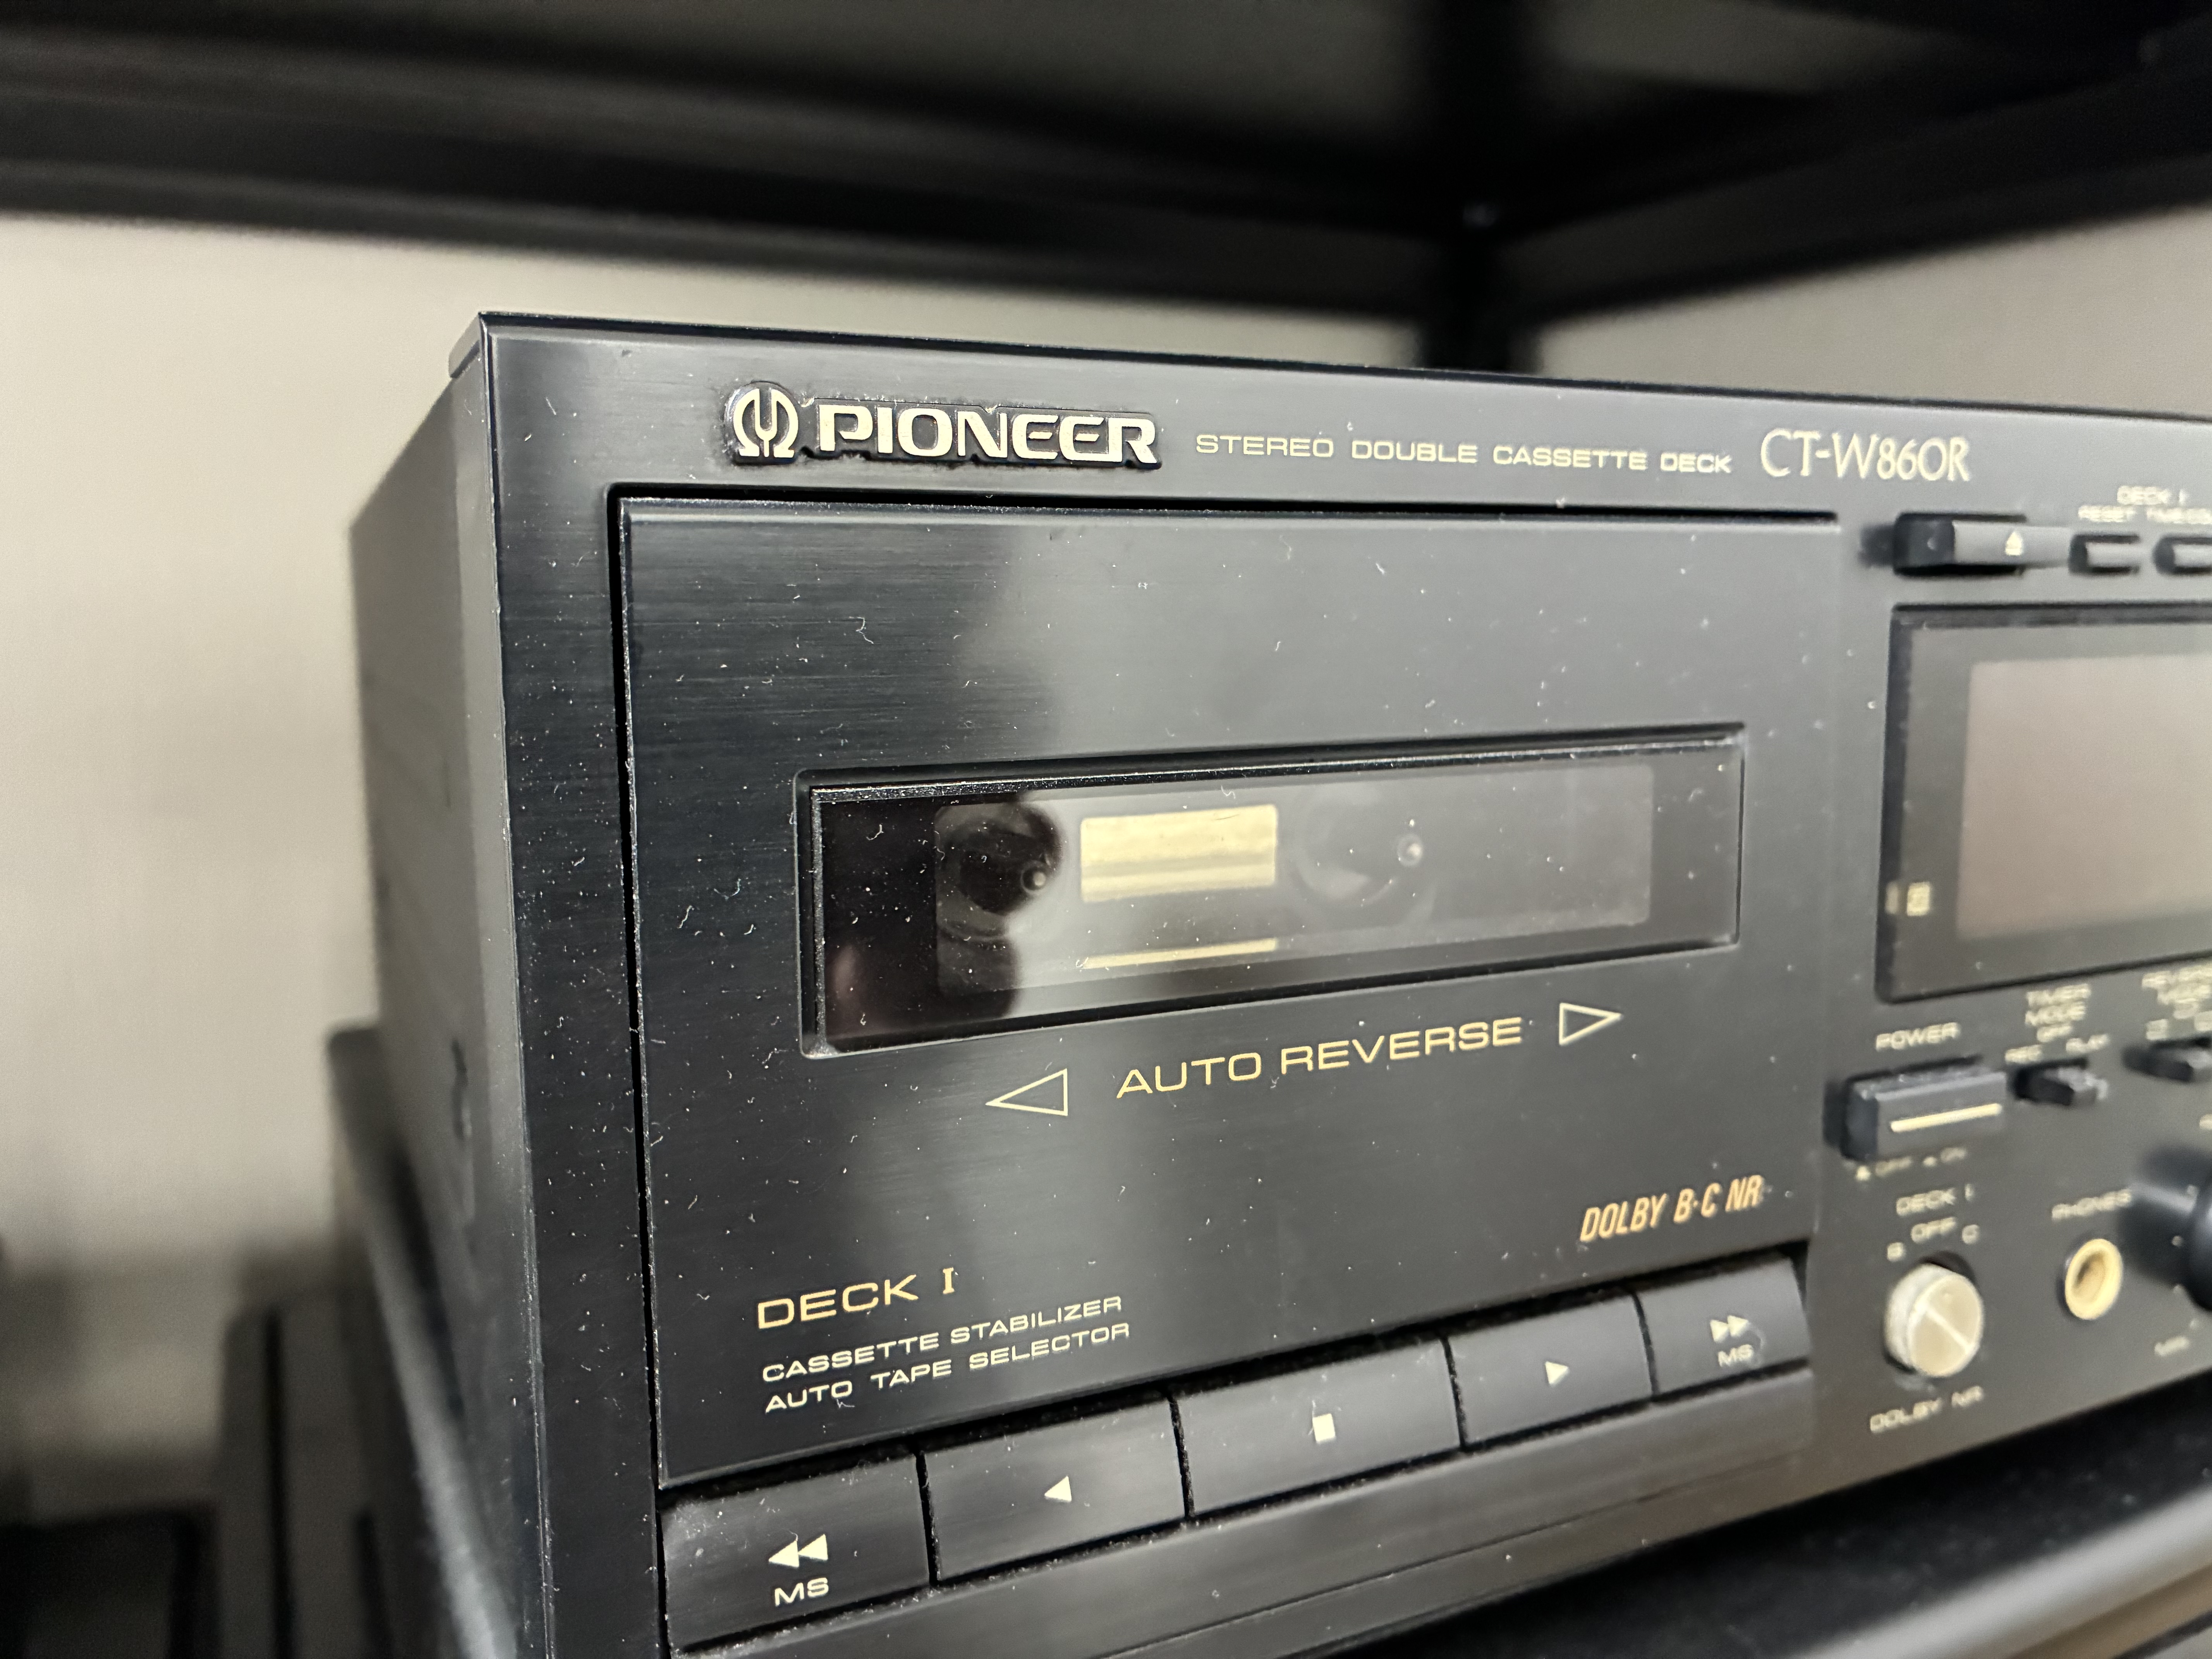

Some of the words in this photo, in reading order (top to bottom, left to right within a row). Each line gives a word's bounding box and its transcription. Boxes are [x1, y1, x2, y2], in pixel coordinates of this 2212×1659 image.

[818, 404, 1158, 464] PIONEER
[1196, 434, 1334, 458] STEREO
[1351, 440, 1478, 464] DOUBLE
[1492, 445, 1648, 471] CASSETTE
[1660, 452, 1732, 474] DECK
[1760, 428, 1971, 482] CT-W860R
[1116, 1052, 1262, 1099] AUTO
[1281, 1016, 1523, 1075] REVERSE
[1875, 1022, 1960, 1050] POWER
[1580, 1193, 1668, 1242] DOLBY
[1725, 1174, 1764, 1212] NR
[1896, 1188, 1956, 1216] DECK
[757, 1274, 919, 1329] DECK
[942, 1267, 955, 1295] I
[763, 1333, 939, 1382] CASSETTE
[950, 1296, 1122, 1344] STABILIZER
[1717, 1344, 1754, 1367] MS
[765, 1380, 853, 1413] AUTO
[870, 1359, 952, 1389] TAPE
[969, 1322, 1130, 1370] SELECTOR
[1870, 1398, 1942, 1432] DOLBY
[775, 1577, 829, 1607] MS
